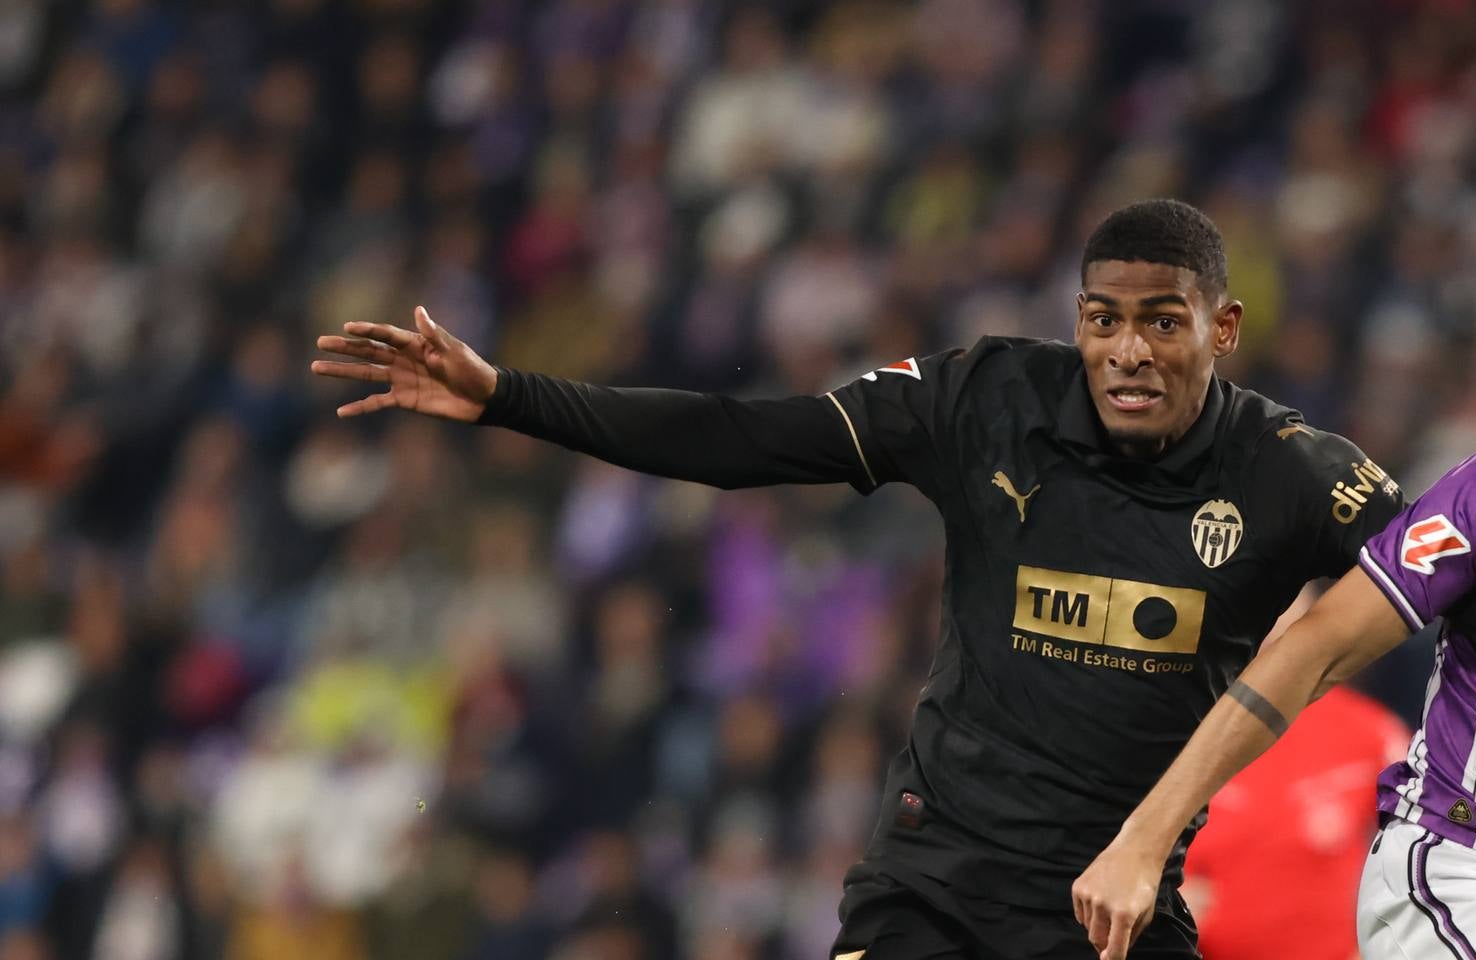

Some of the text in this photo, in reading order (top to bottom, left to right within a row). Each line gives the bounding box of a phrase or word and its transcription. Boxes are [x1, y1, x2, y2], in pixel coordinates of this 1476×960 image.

[1027, 586, 1090, 627] TM
[1011, 633, 1194, 674] TM Real Estate Group
